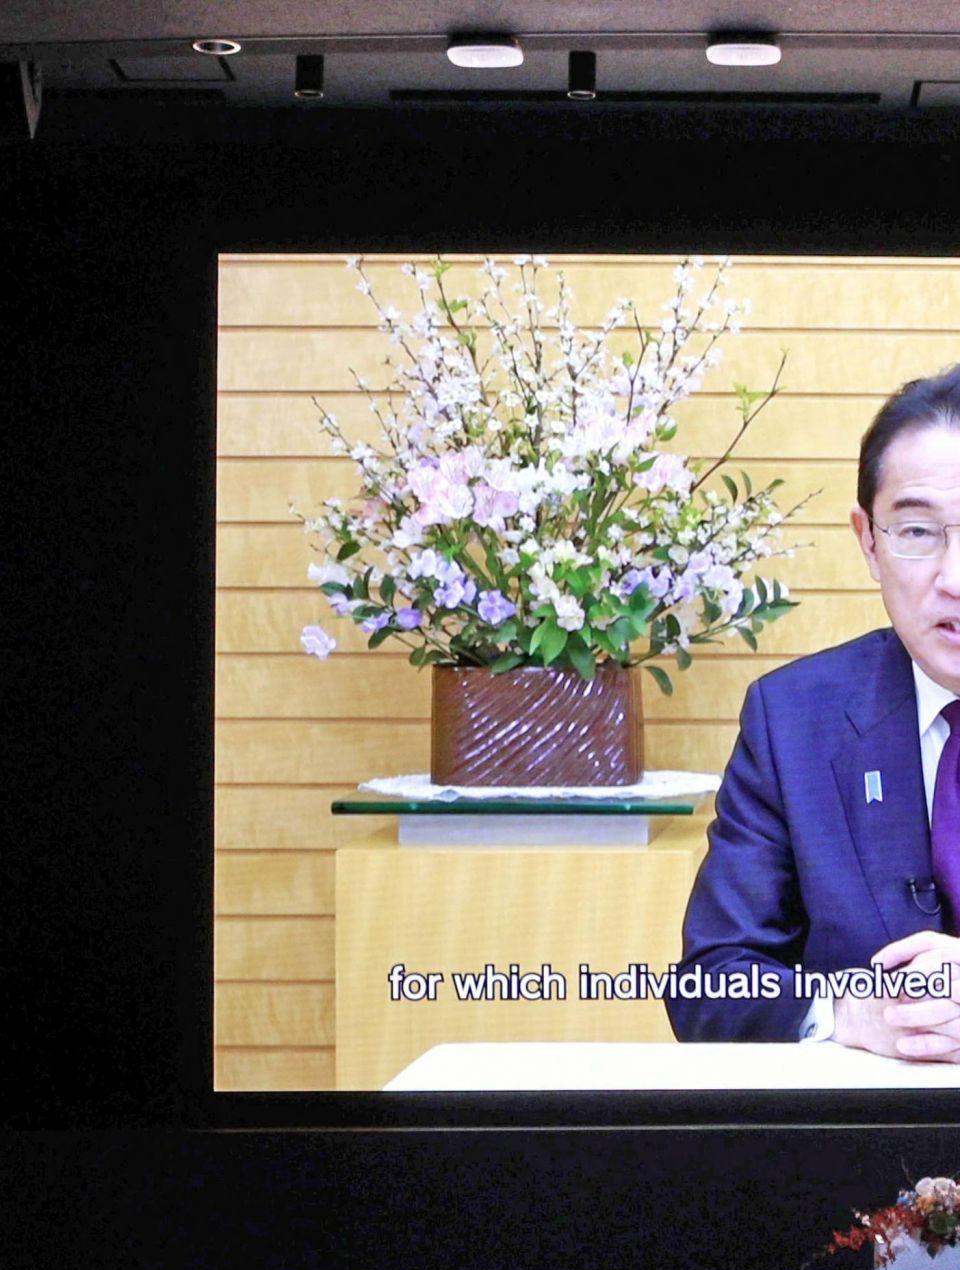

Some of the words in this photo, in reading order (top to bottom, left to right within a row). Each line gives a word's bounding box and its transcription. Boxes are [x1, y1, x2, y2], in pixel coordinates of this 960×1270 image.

[388, 964, 444, 1001] for
[452, 964, 567, 1001] which
[578, 963, 782, 1000] individuals
[793, 963, 951, 999] involved
